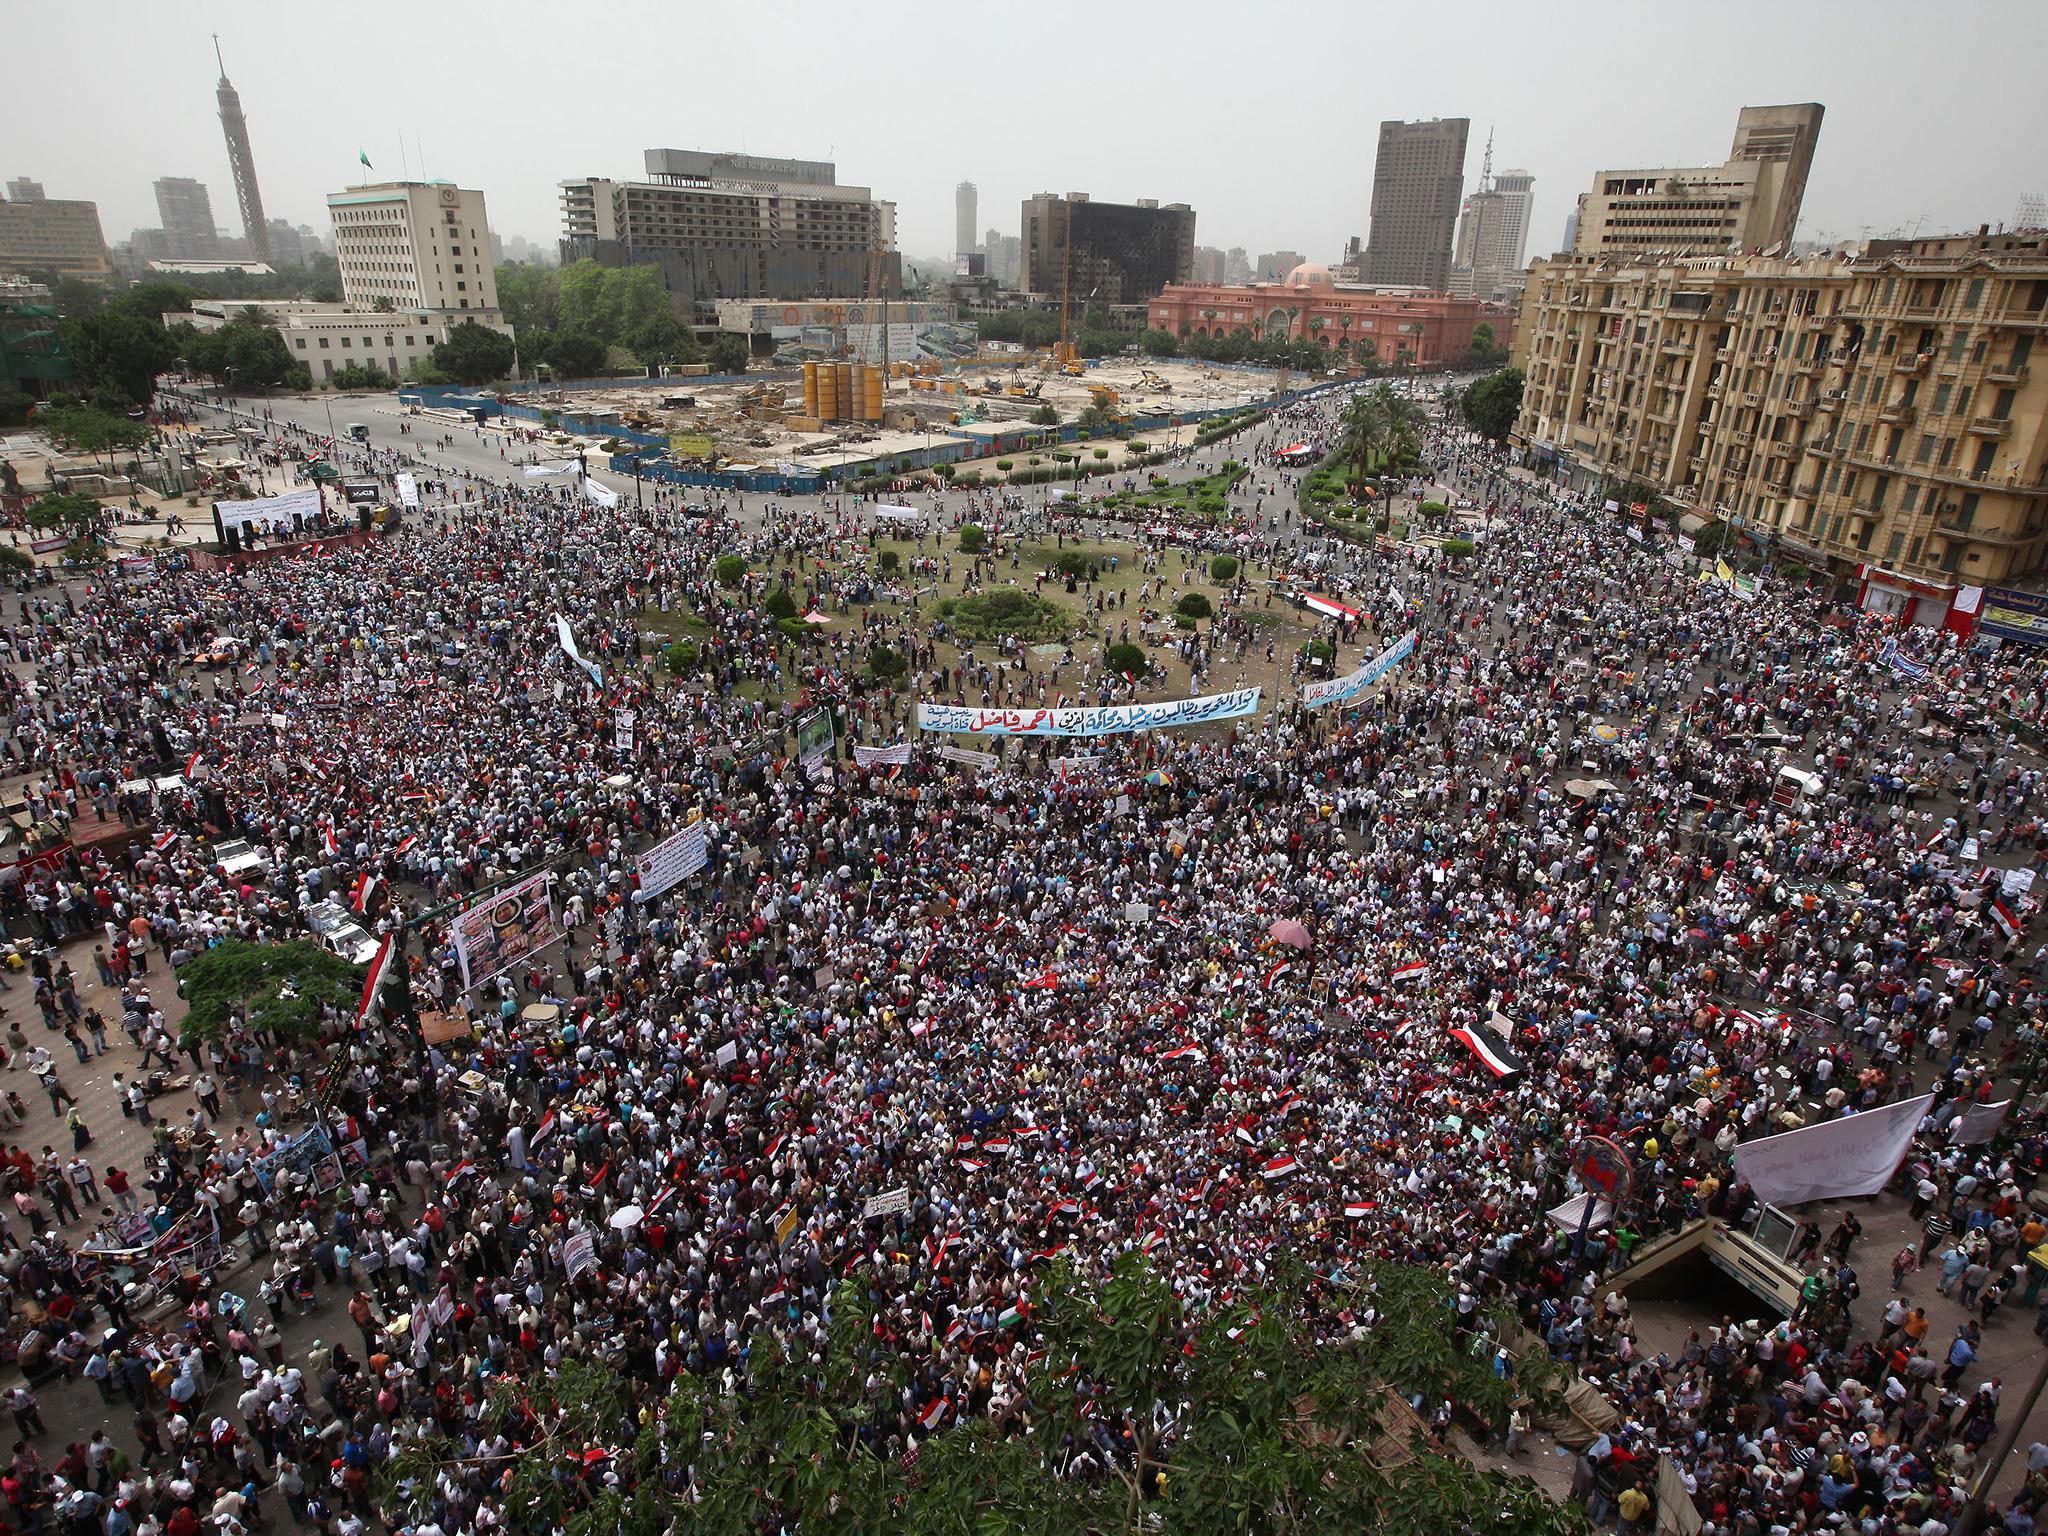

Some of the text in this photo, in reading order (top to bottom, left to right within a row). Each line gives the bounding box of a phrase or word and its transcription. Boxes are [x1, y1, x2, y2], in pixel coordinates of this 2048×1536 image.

[1223, 690, 1254, 712] ثوار
[969, 710, 1021, 733] فاضل
[1058, 711, 1085, 733] الفريق
[1122, 706, 1152, 729] برحيل
